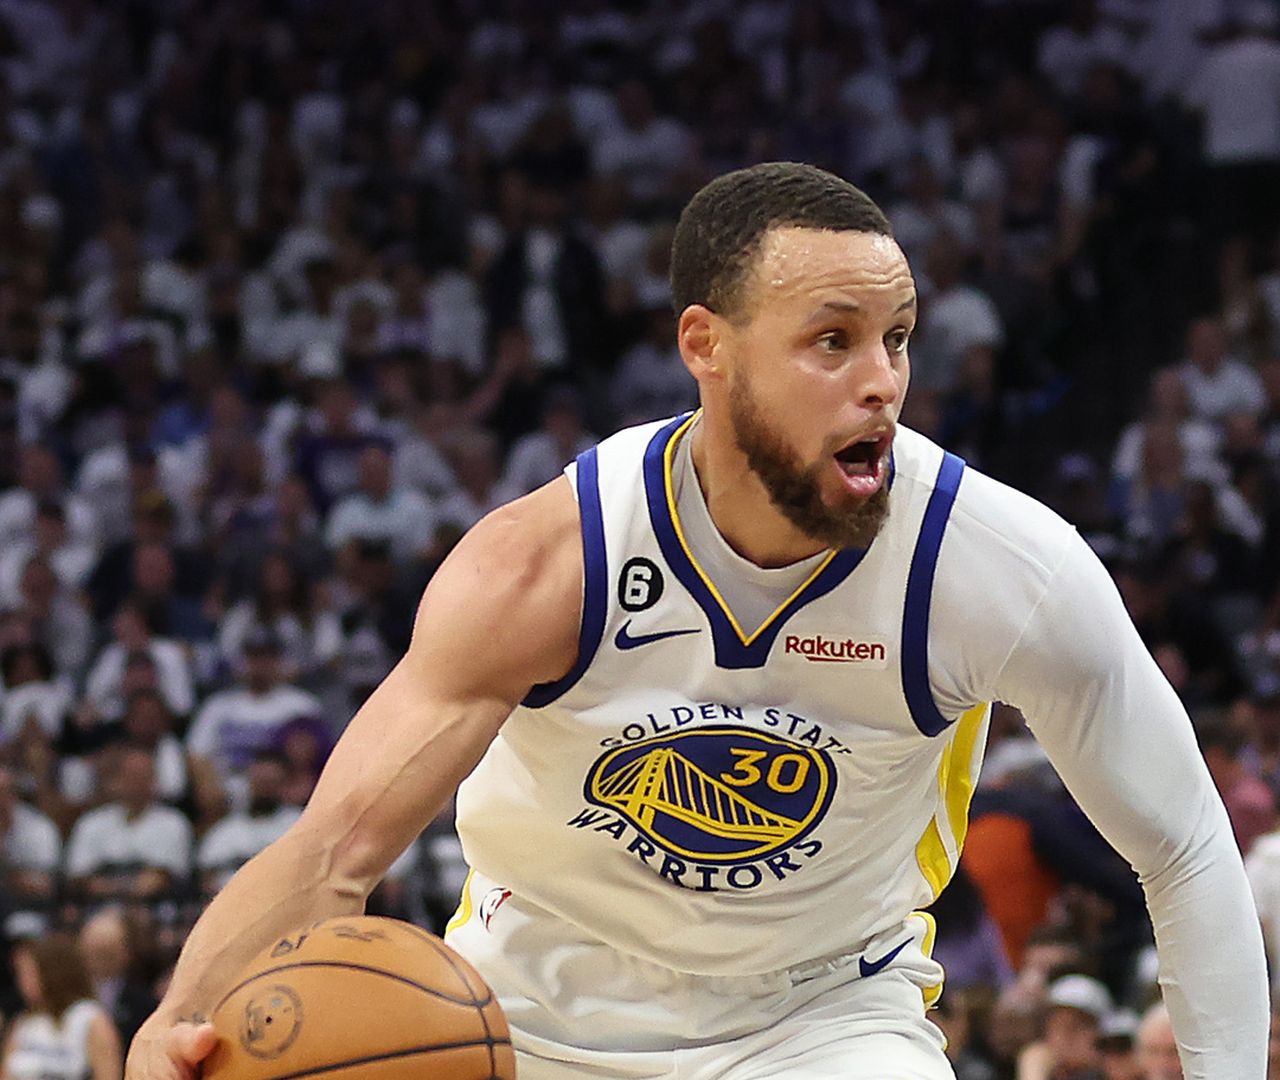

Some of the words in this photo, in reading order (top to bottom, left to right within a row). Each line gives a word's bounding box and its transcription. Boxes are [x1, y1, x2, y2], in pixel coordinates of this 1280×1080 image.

[623, 562, 652, 608] 6
[785, 635, 885, 663] Rakuten
[719, 747, 811, 794] 30
[566, 808, 823, 893] WARRIORS
